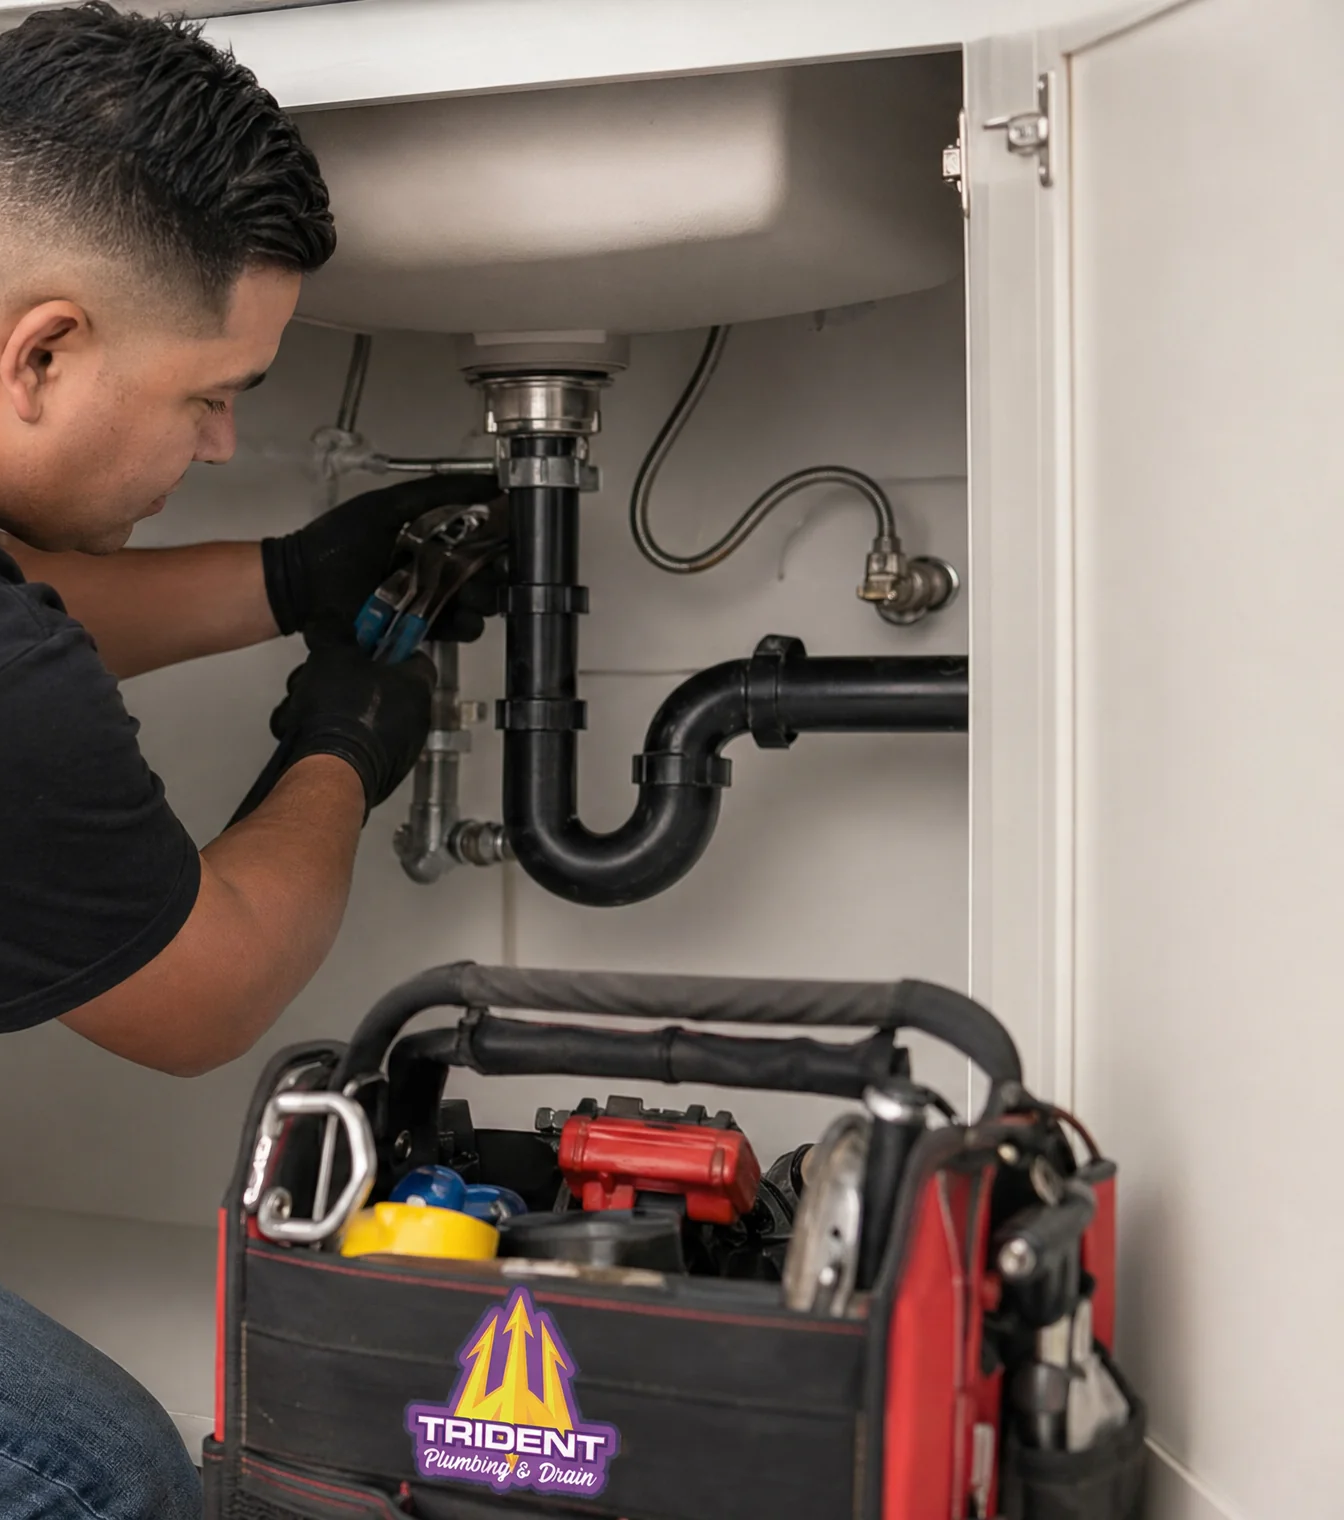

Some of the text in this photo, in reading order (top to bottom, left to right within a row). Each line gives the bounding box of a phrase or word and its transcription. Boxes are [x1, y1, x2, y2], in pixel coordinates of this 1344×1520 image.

[418, 1415, 605, 1461] TRIDENT
[423, 1448, 598, 1487] Plumbing & Drain
